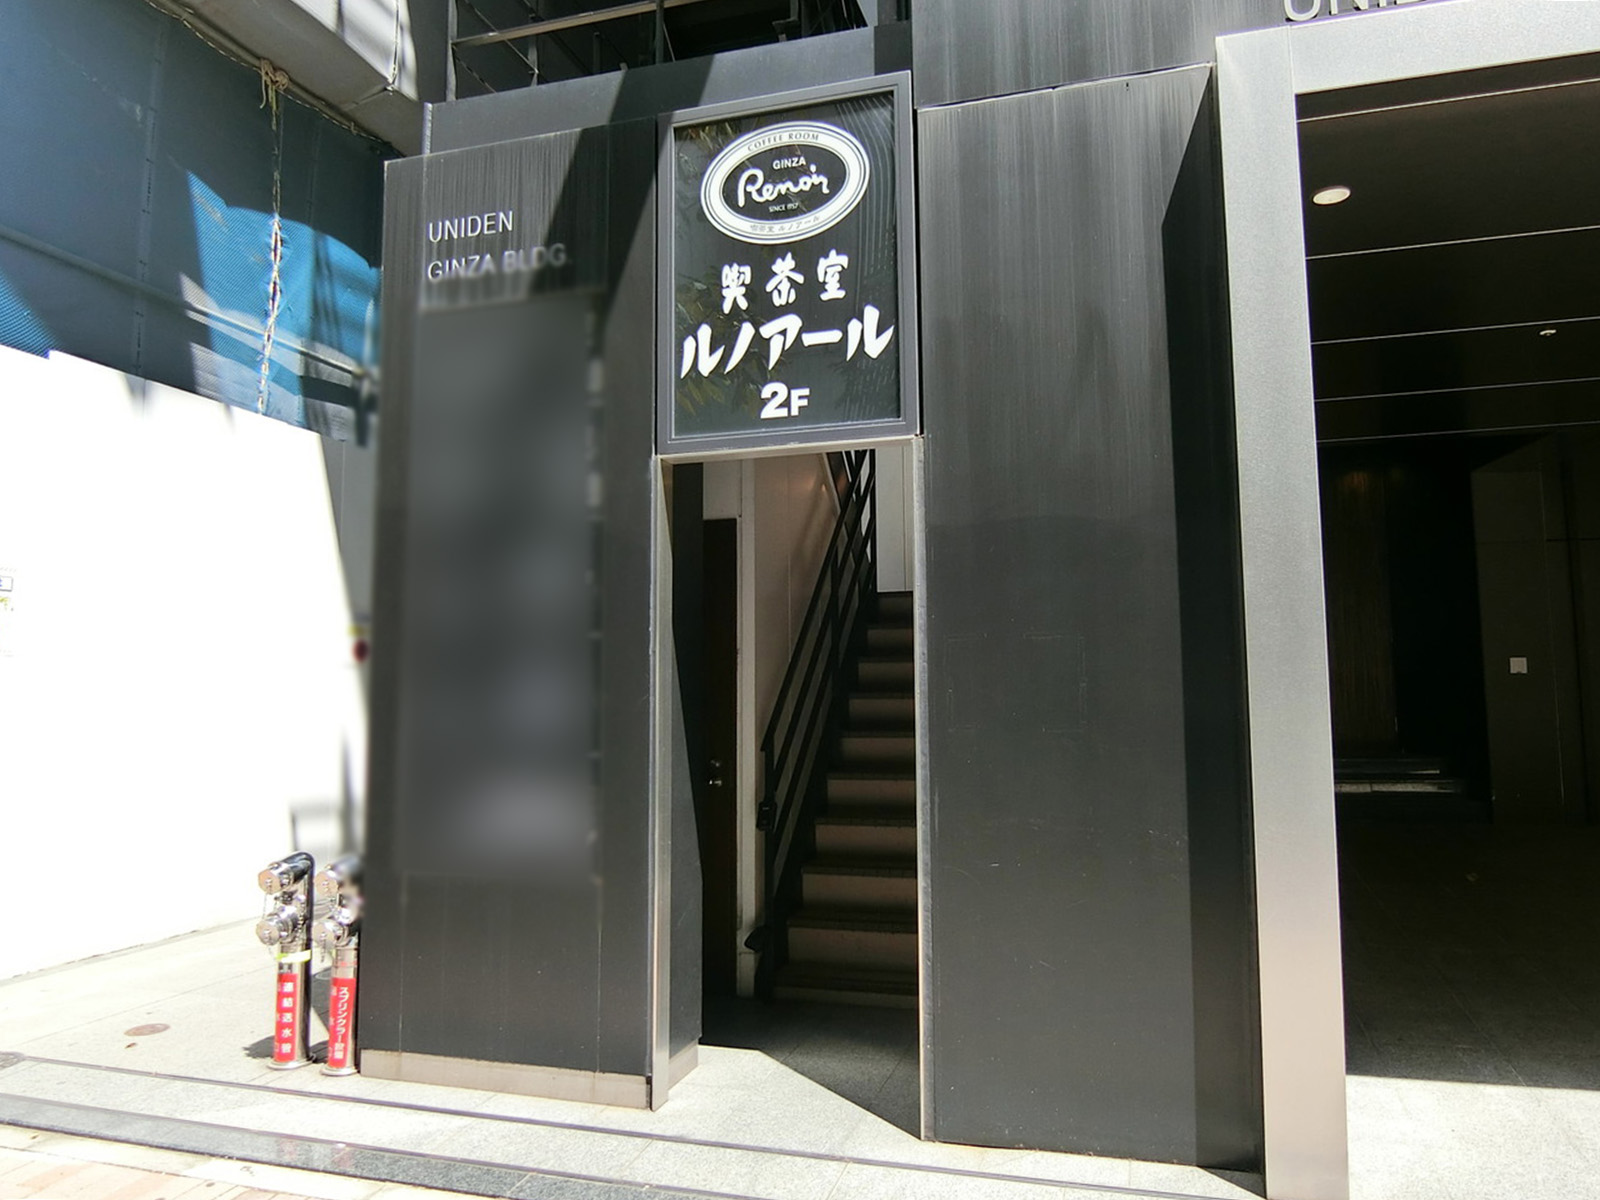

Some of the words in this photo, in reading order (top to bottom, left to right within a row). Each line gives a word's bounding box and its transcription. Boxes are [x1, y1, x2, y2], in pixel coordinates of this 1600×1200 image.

[747, 134, 783, 152] COFFEE
[788, 132, 820, 142] ROOM
[772, 156, 807, 170] GINZA
[738, 164, 830, 208] Renoir
[429, 211, 514, 243] UNIDEN
[427, 254, 496, 284] GINZA
[722, 249, 849, 314] 喫茶室
[680, 304, 895, 379] ルノアール
[760, 381, 811, 419] 2F
